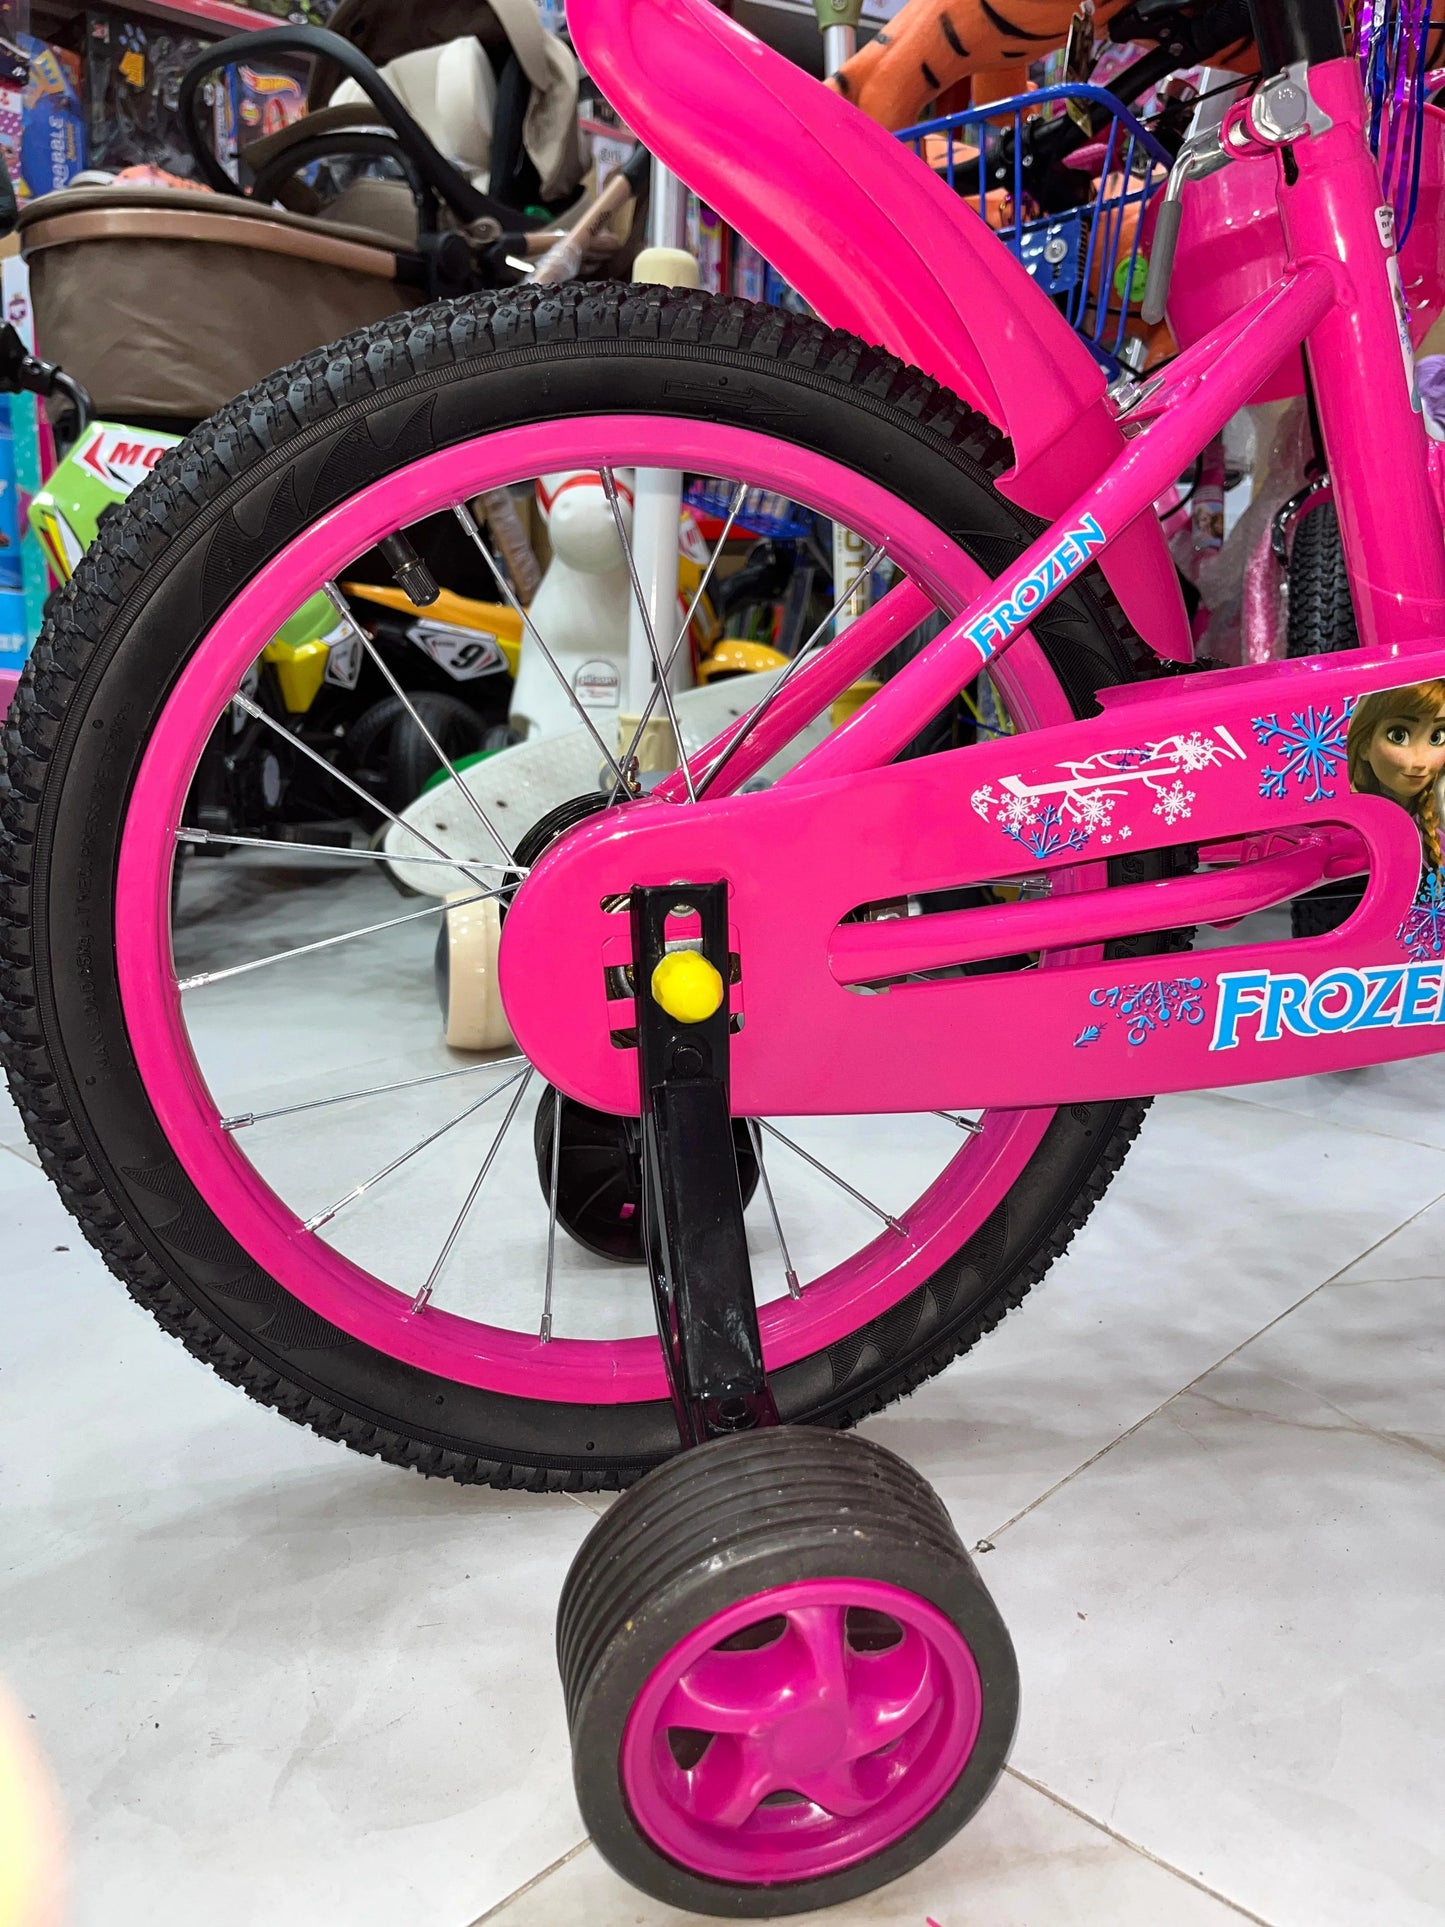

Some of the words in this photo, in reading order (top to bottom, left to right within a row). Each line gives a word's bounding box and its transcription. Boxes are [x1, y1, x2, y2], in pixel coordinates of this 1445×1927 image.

[962, 511, 1107, 663] FROZEN
[450, 643, 486, 670] 9
[1208, 958, 1445, 1051] FROZE
